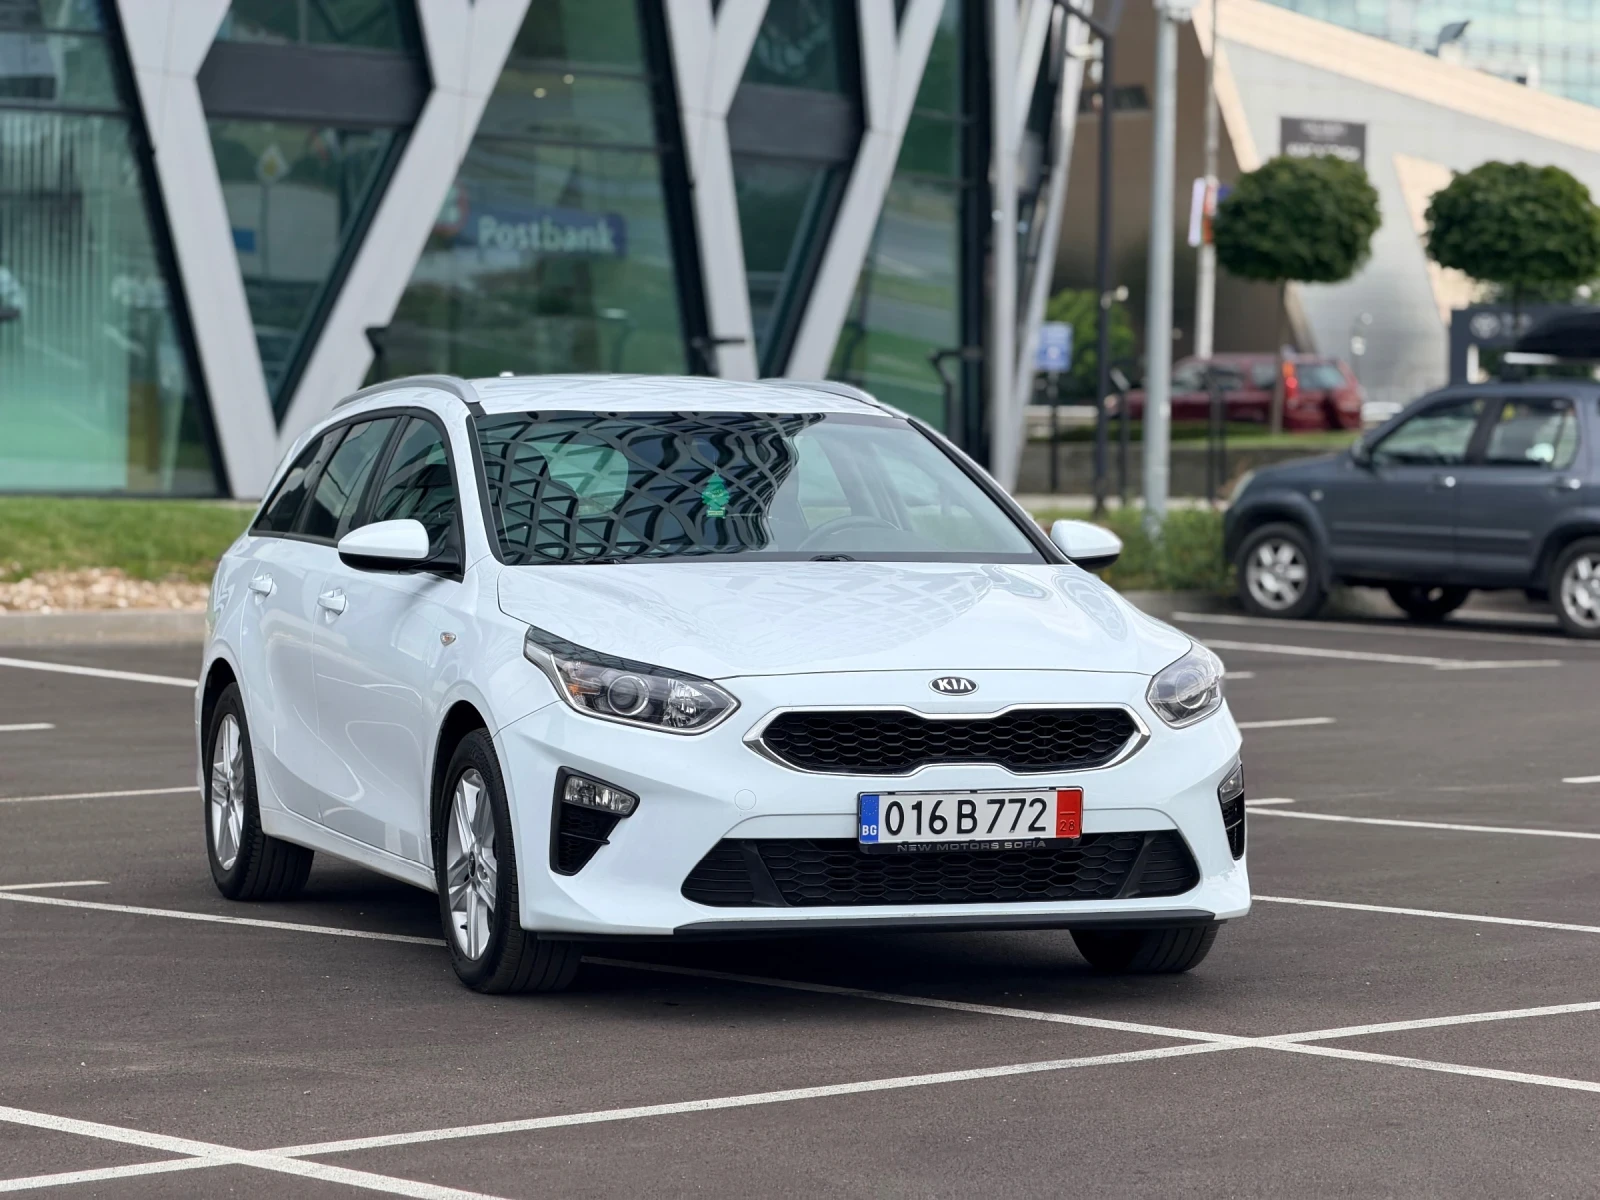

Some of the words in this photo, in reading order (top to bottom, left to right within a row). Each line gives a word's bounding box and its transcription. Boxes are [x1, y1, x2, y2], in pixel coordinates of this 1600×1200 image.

[478, 215, 615, 252] Postbank
[936, 678, 973, 691] KIA
[862, 825, 877, 836] BG
[1060, 820, 1075, 832] 28
[897, 844, 932, 852] NEW
[937, 842, 1000, 850] MOTORS
[1004, 840, 1047, 849] SOFIA
